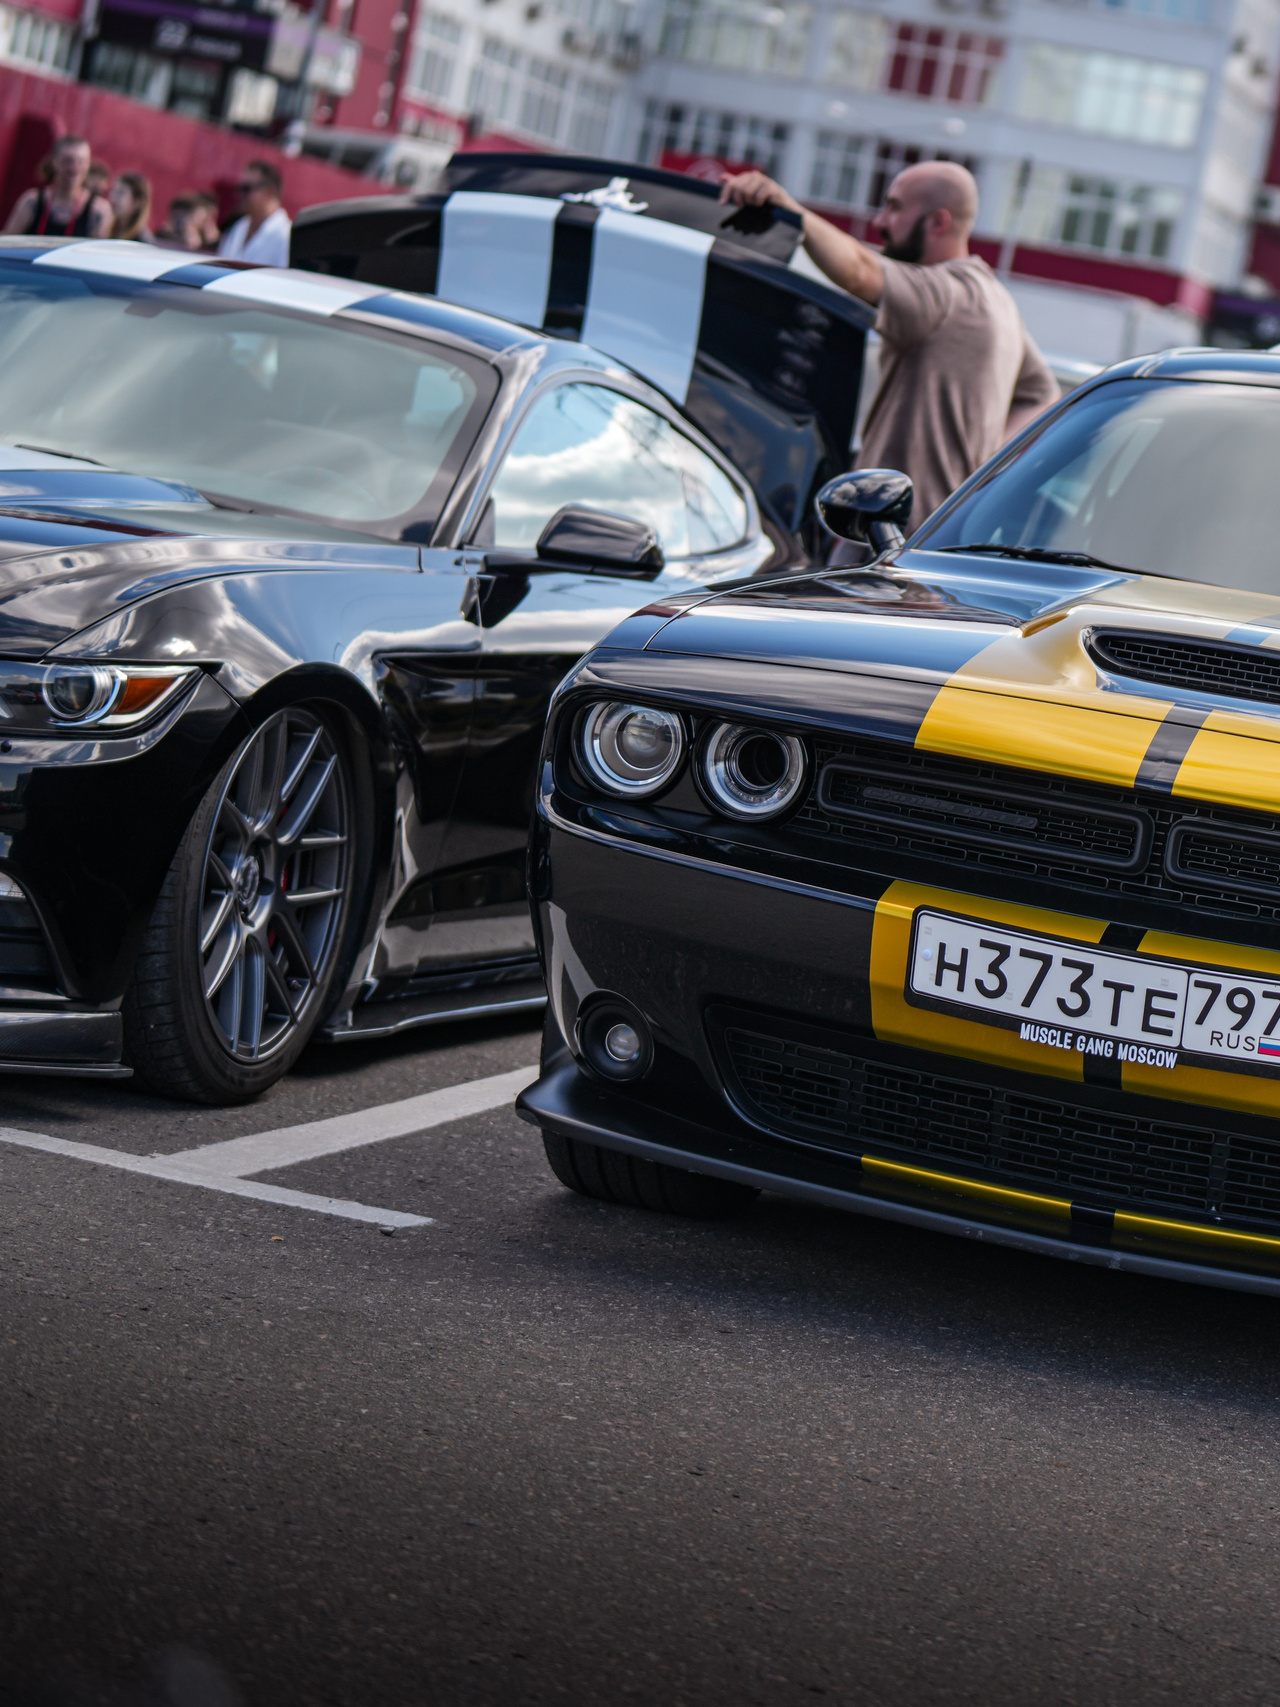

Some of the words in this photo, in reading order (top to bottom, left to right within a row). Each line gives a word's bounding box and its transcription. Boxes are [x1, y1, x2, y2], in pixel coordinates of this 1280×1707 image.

[1019, 1022, 1073, 1050] MUSCLE
[1076, 1035, 1114, 1058] GANG
[1117, 1042, 1178, 1069] MOSCOW
[1209, 1030, 1256, 1052] RUS
